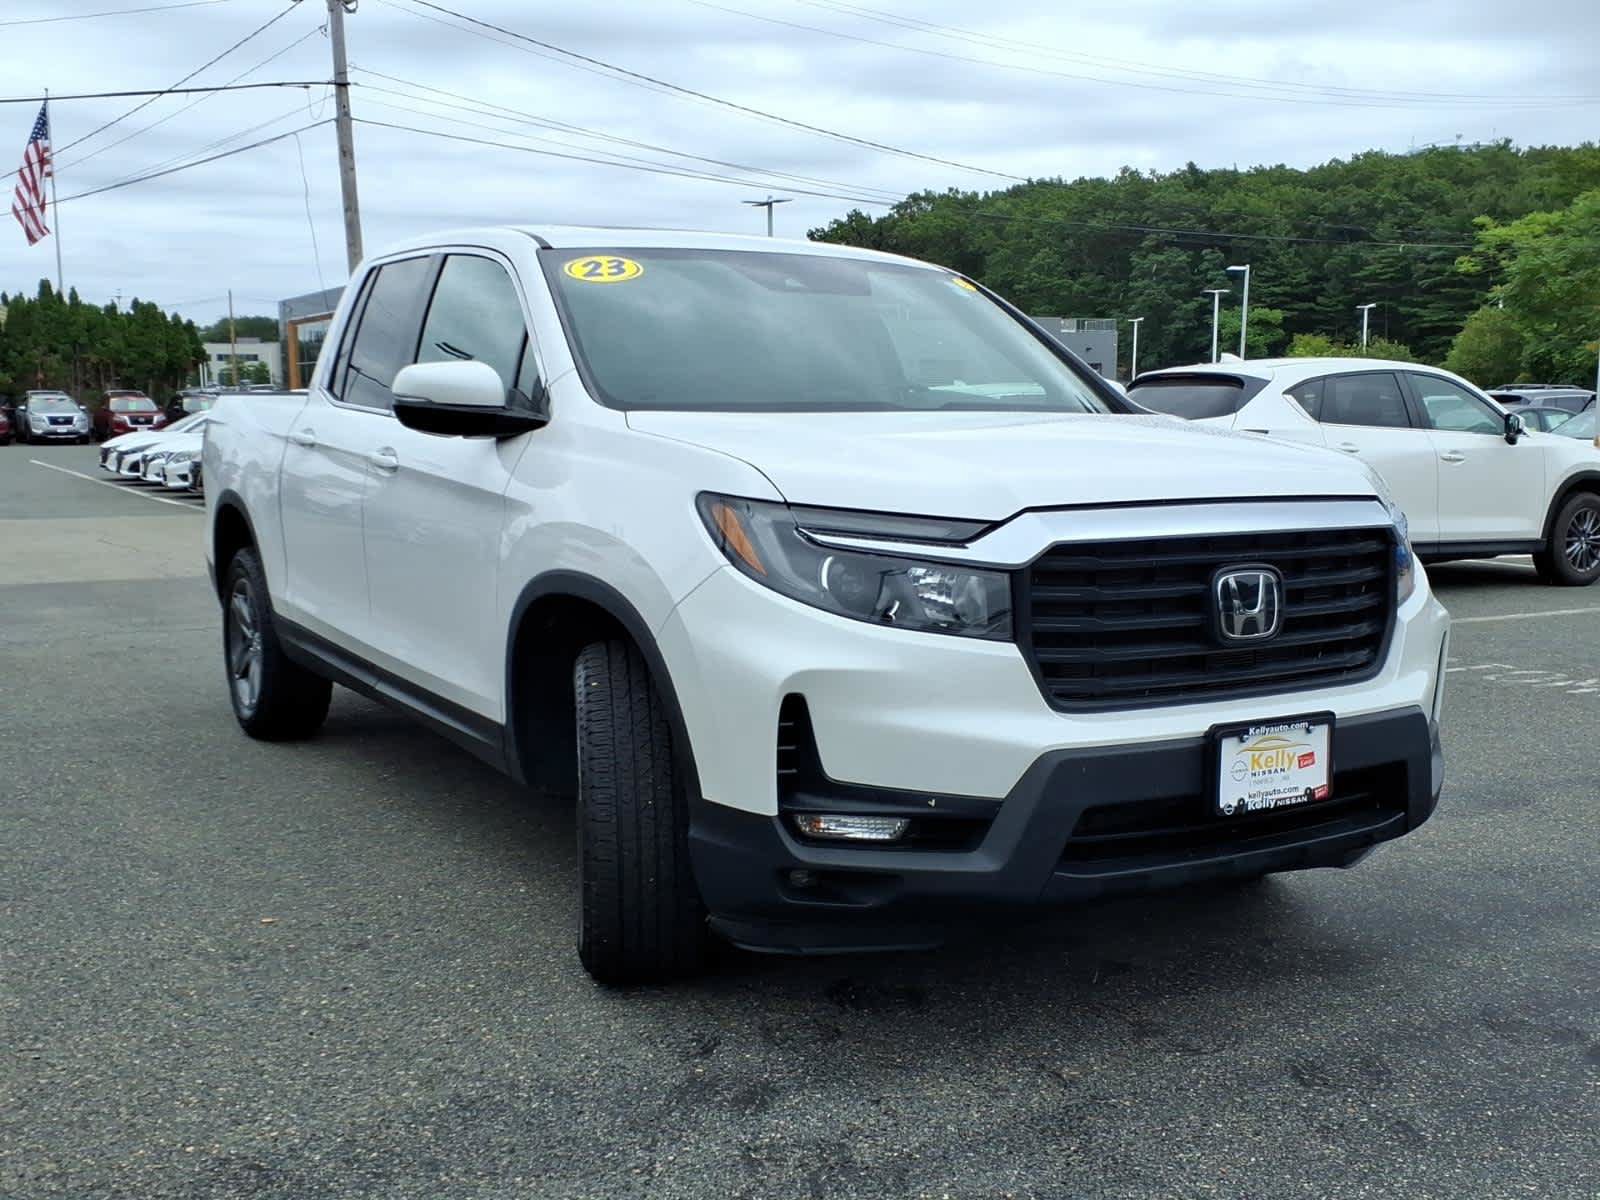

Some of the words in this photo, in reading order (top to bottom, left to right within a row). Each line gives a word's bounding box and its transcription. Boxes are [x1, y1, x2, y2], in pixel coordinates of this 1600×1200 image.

[581, 259, 626, 277] 23
[1248, 721, 1309, 735] Kellyauto.com
[1251, 750, 1297, 771] Kelly
[1250, 768, 1286, 777] NISSAN
[1247, 786, 1300, 800] kellyauto.com
[1247, 797, 1276, 811] Kelly
[1276, 795, 1308, 806] NISSAN
